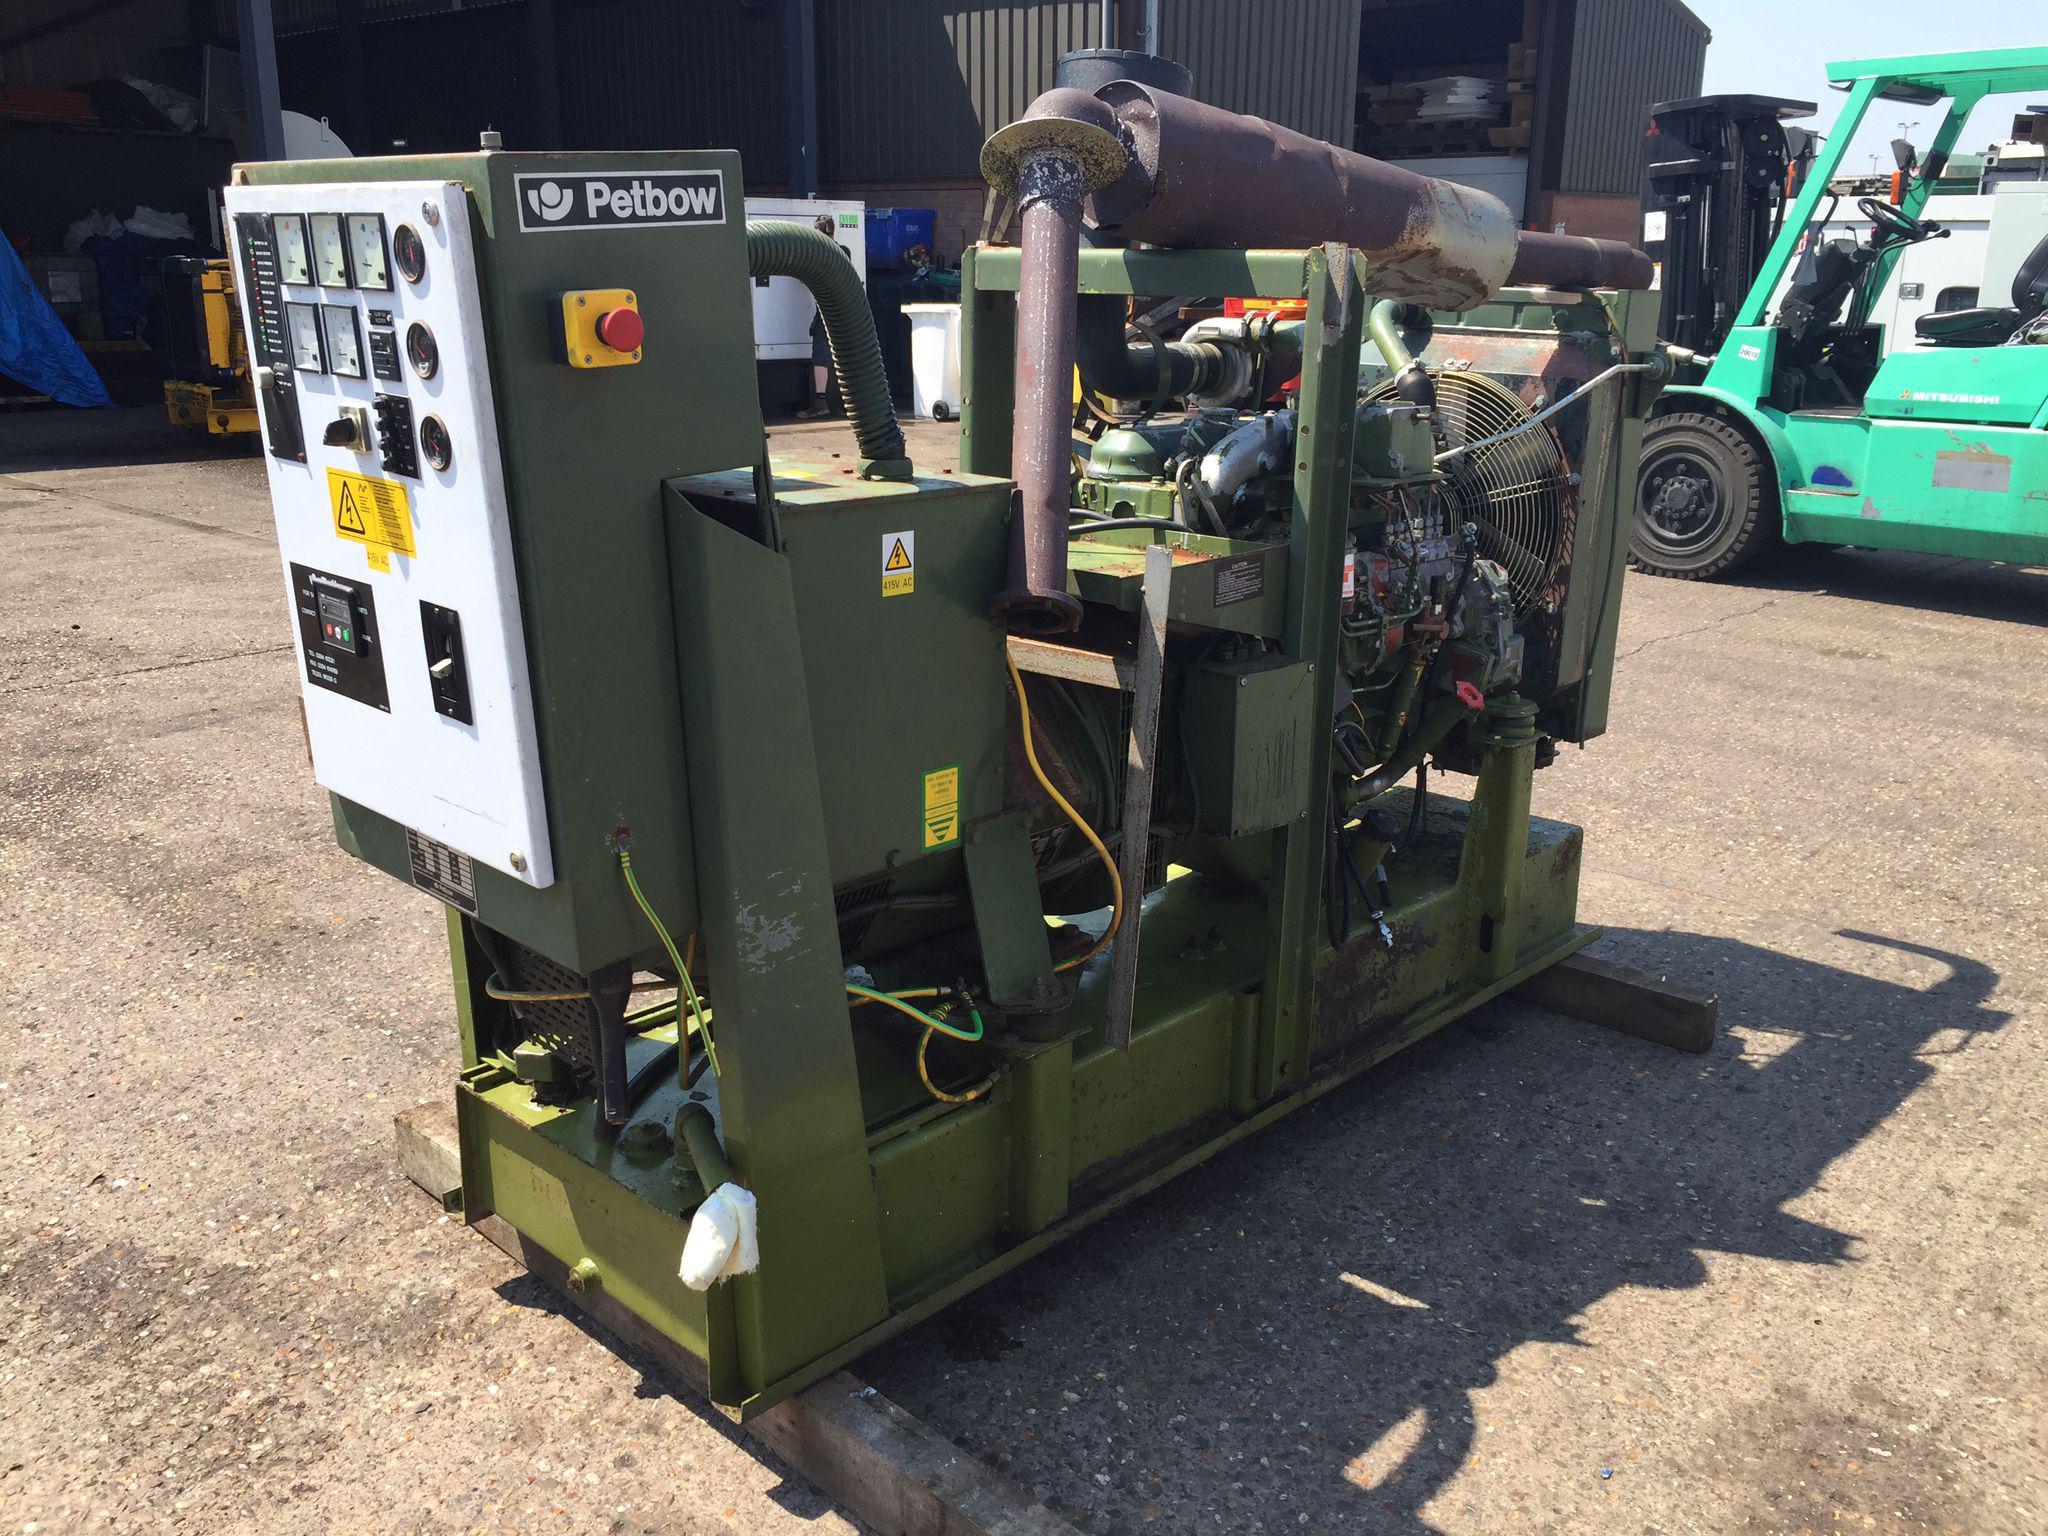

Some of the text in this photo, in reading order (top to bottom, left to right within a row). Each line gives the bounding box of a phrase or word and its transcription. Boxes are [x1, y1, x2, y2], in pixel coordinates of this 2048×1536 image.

[585, 180, 717, 219] Petbow
[1913, 391, 2000, 405] MITSUBISHI
[883, 577, 913, 590] 415V AC
